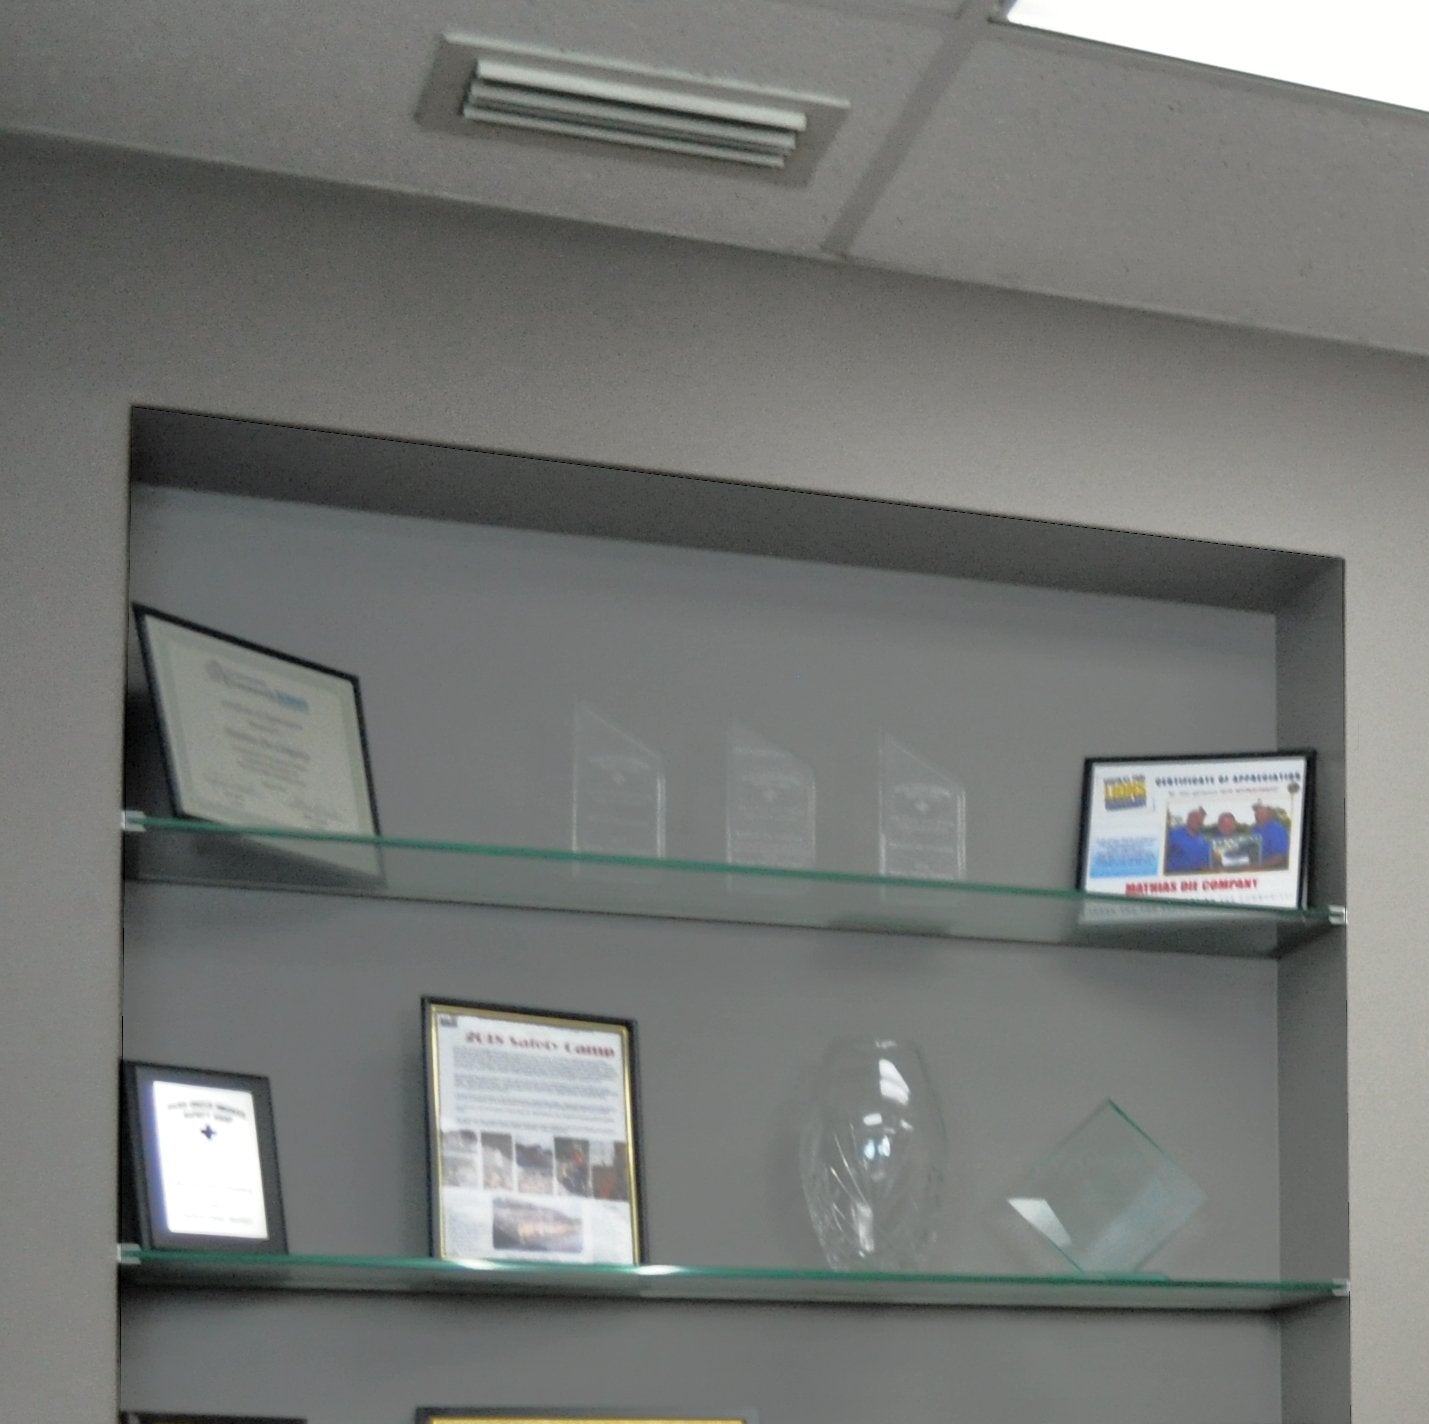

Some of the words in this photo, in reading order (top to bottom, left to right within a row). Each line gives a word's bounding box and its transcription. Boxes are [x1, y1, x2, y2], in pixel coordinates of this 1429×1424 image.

[1125, 882, 1177, 896] MATHIAS
[1201, 879, 1259, 891] COMPANY
[508, 1036, 560, 1052] Safety
